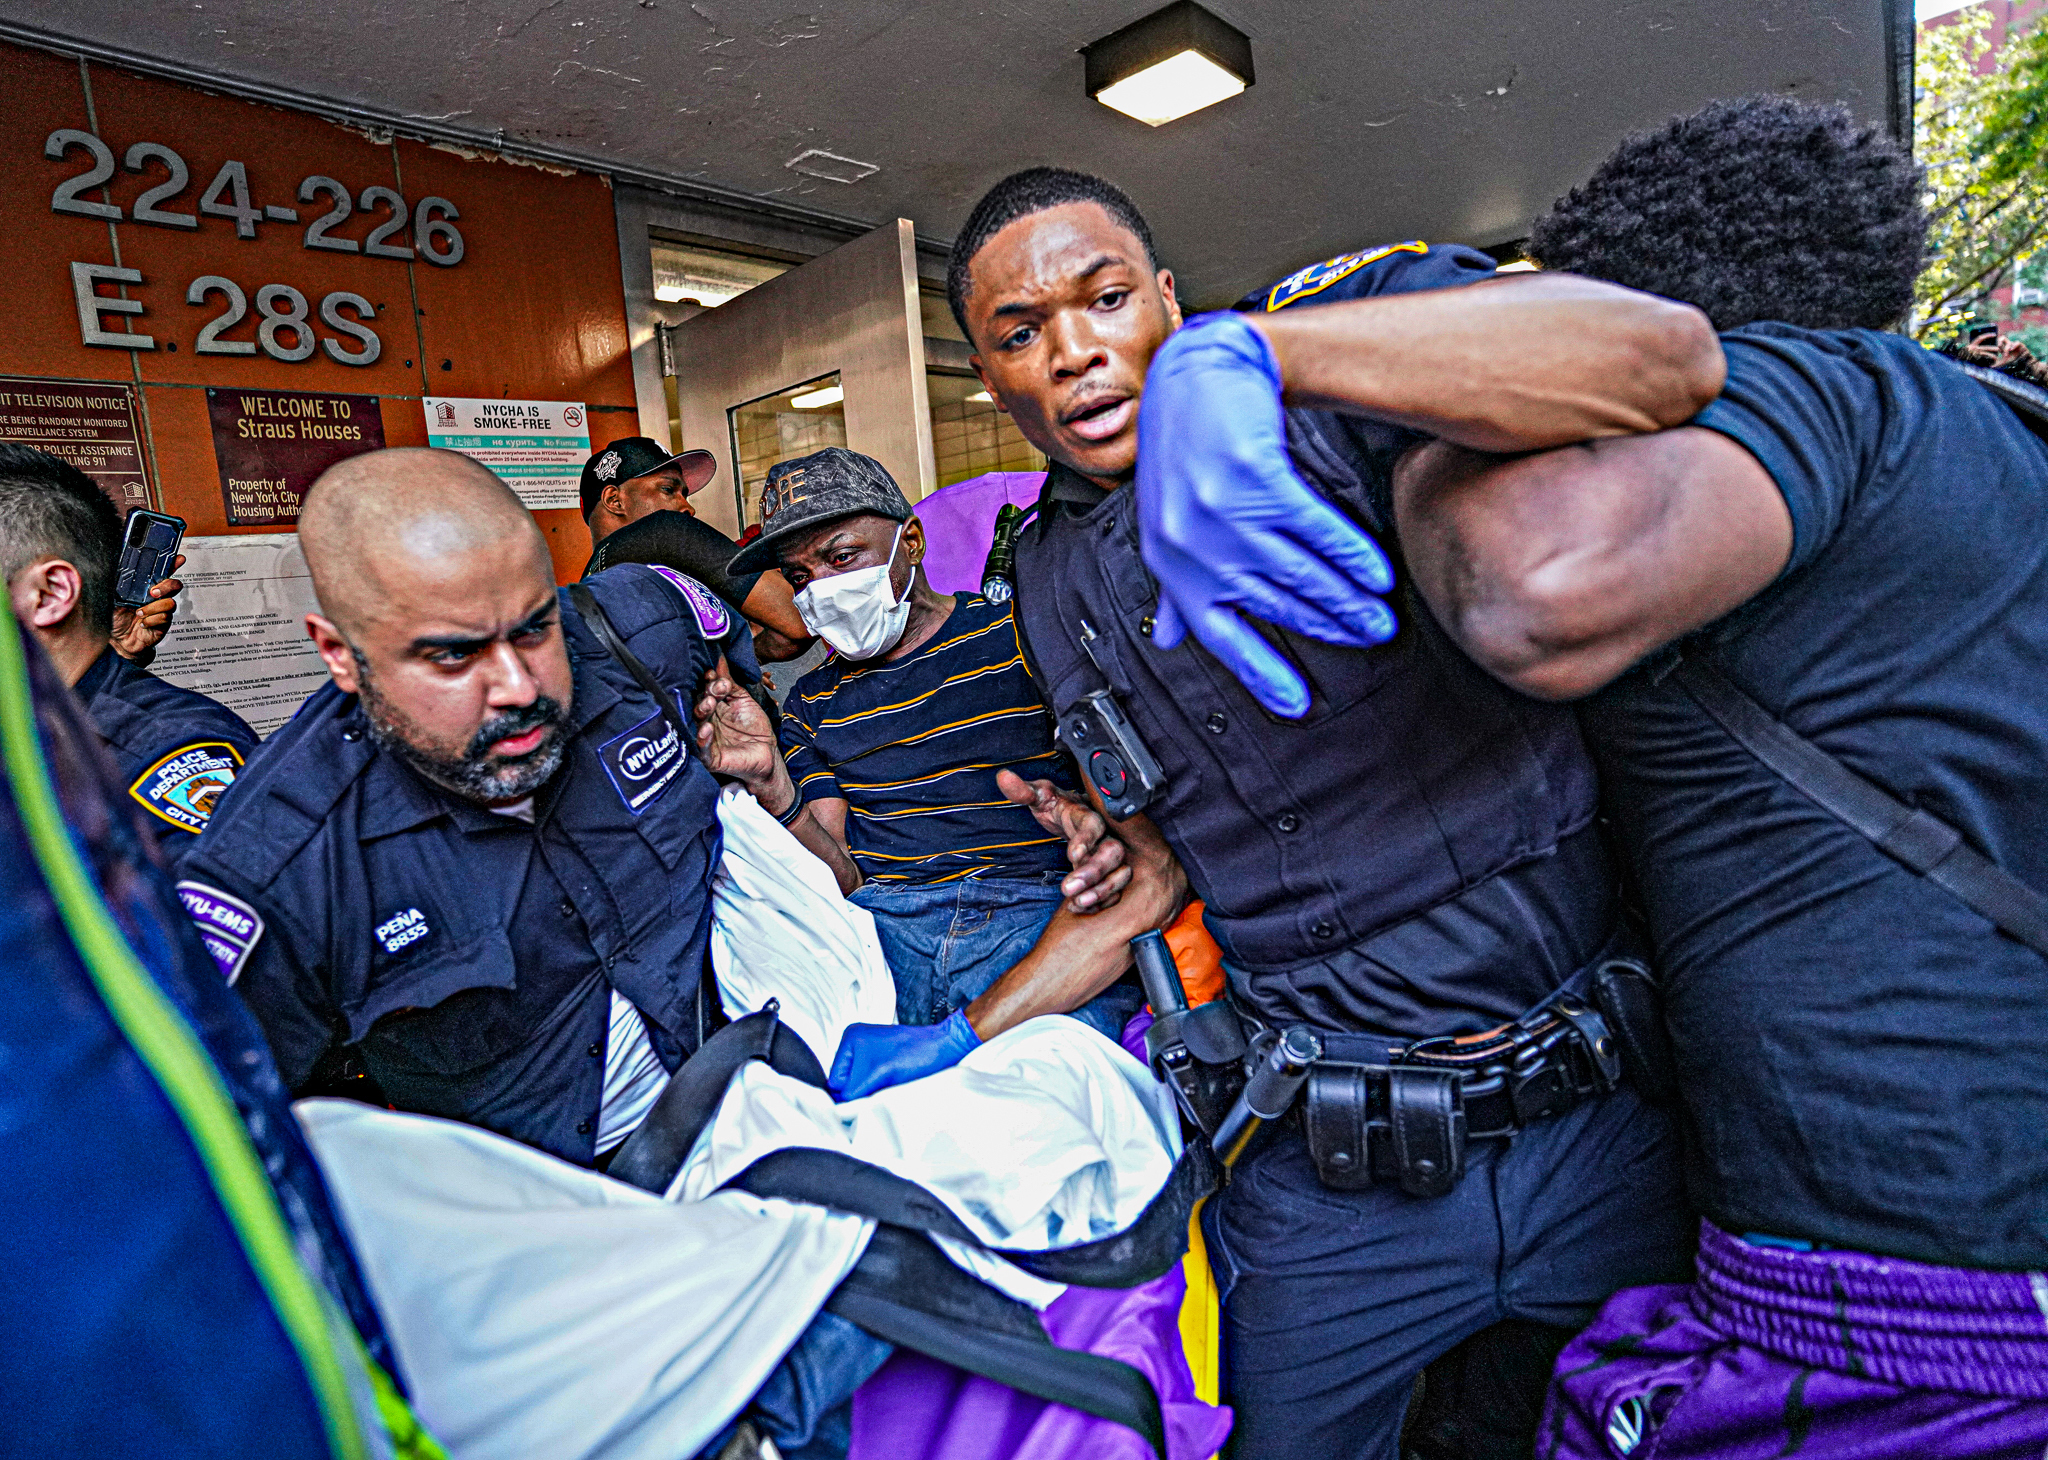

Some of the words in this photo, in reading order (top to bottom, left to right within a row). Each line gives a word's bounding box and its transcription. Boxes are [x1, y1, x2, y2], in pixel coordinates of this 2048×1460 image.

[45, 129, 465, 268] 224-226
[70, 261, 156, 350] E
[186, 275, 381, 367] 28S
[14, 394, 83, 408] TELEVISION
[86, 397, 127, 410] NOTICE
[240, 396, 327, 418] WELCOME
[329, 400, 351, 419] TO
[483, 405, 524, 417] NYCHA
[528, 406, 539, 417] IS
[11, 416, 36, 425] BEING
[39, 417, 81, 426] RANDOMLY
[83, 419, 128, 428] MONITORED
[237, 418, 296, 439] Straus
[300, 420, 362, 440] Houses
[474, 417, 551, 430] SMOKE-FREE
[5, 426, 67, 436] SURVEILLANCE
[69, 428, 98, 437] SYSTEM
[43, 445, 78, 455] POLICE
[80, 446, 134, 456] ASSISTANCE
[92, 457, 107, 467] 911
[229, 478, 273, 492] Property
[276, 478, 286, 490] of
[230, 492, 254, 503] New
[255, 491, 279, 503] York
[281, 491, 300, 506] City
[232, 505, 275, 519] Housing
[157, 750, 210, 779] POLICE
[626, 743, 656, 772] NYU
[149, 757, 234, 800] DEPARTMENT
[166, 806, 201, 825] CITY
[375, 908, 426, 942] PEÑA
[385, 921, 430, 952] 8835
